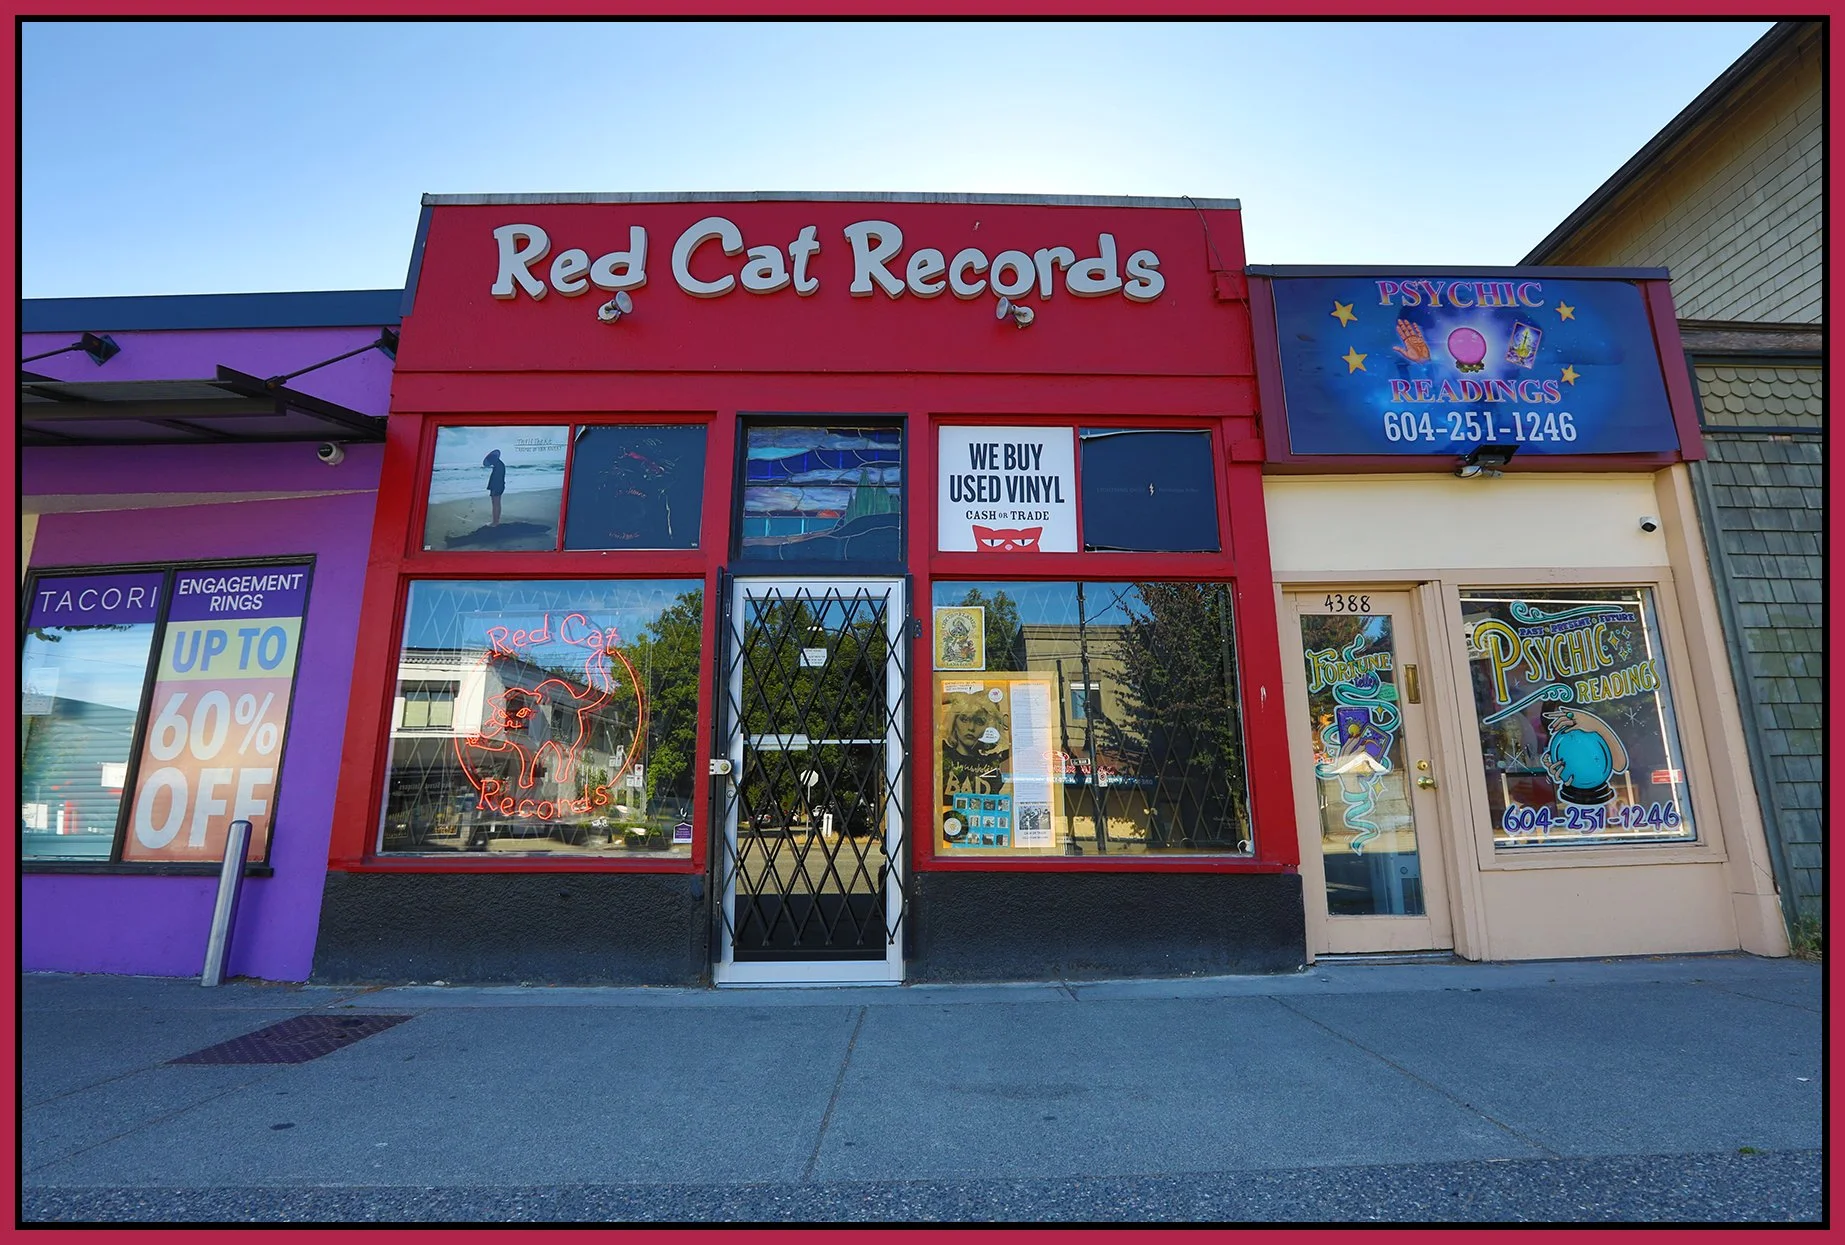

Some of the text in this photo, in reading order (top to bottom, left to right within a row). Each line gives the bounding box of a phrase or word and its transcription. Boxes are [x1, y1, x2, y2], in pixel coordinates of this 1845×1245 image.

[491, 216, 1166, 302] Red Cat Records
[1374, 279, 1544, 308] PSYCHIC
[1389, 378, 1562, 404] READINGS
[1383, 410, 1578, 442] 604-251-1246
[968, 443, 1043, 471] WE BUY
[949, 474, 1065, 504] USED VINYL
[965, 510, 997, 520] CASH
[1010, 510, 1050, 521] TRADE
[39, 586, 157, 612] TACORI
[178, 573, 303, 595] ENGAGEMENT
[209, 594, 264, 612] RINGS
[1324, 594, 1371, 614] 4388
[487, 613, 620, 658] Red Cat
[1518, 612, 1635, 637] PAST PRESENT FUTURE
[171, 626, 287, 673] UP TO
[1474, 620, 1612, 704] PSYCHIC
[1306, 648, 1392, 693] FORTUNE
[1576, 658, 1661, 703] READINGS
[149, 689, 278, 761] 60%
[134, 767, 273, 849] OFF
[476, 778, 610, 820] Records
[1502, 801, 1681, 835] 604-251-1246
